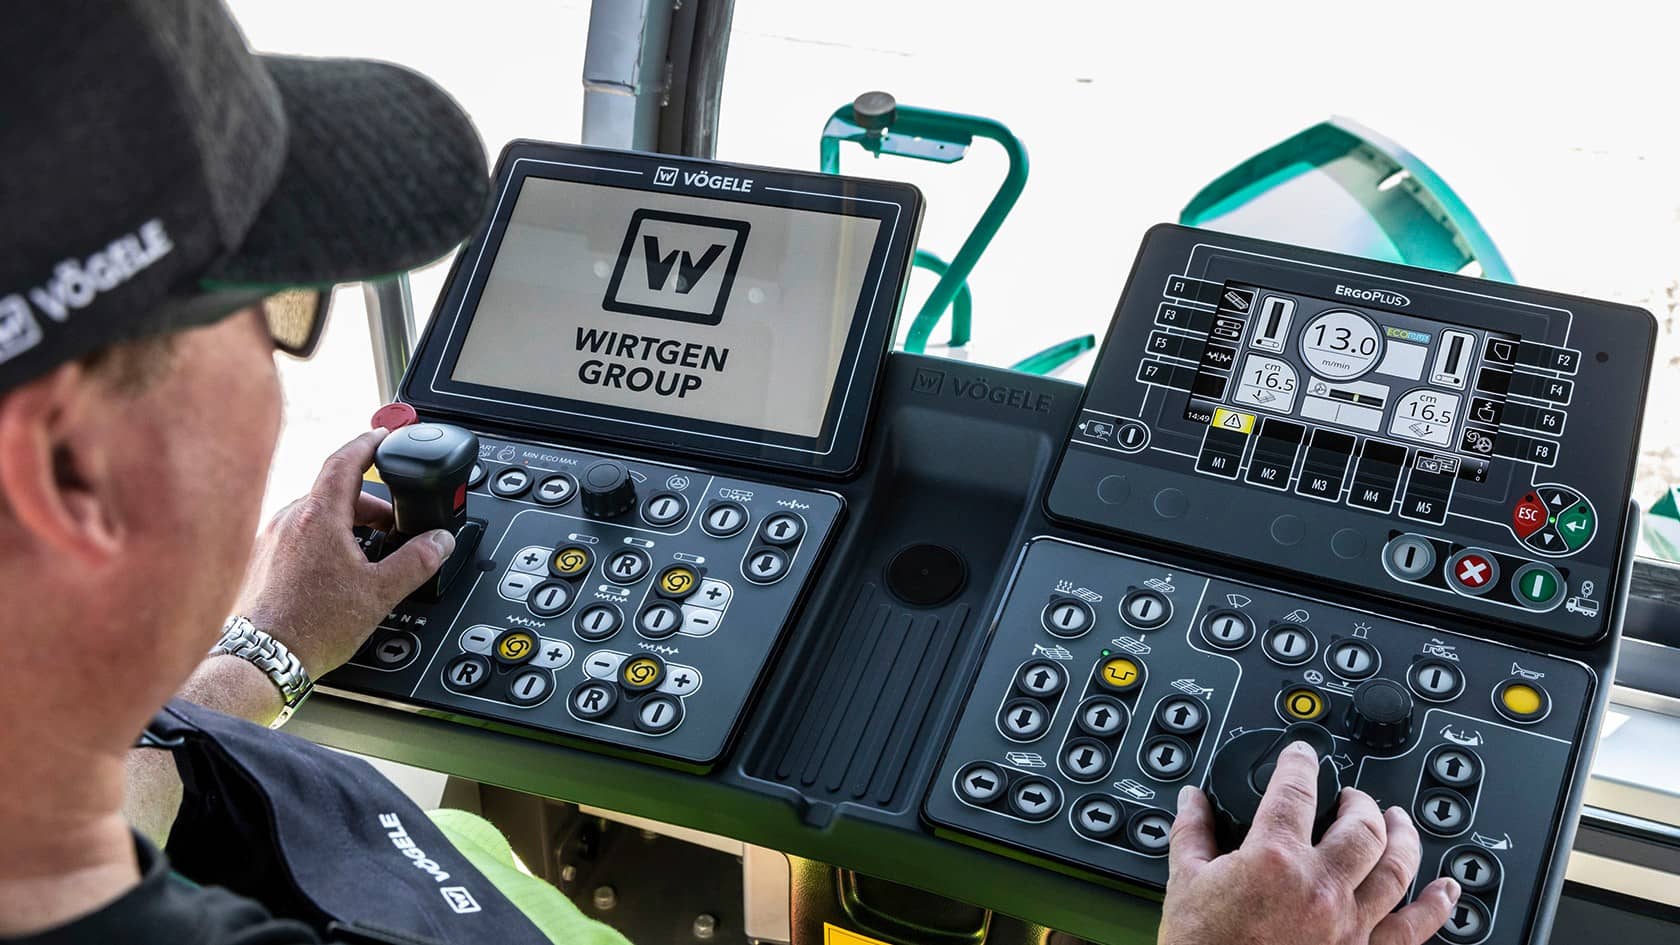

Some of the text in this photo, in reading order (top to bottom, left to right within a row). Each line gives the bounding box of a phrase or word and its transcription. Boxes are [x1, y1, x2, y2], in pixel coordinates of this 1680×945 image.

[684, 170, 754, 193] VÖGELE
[1174, 281, 1186, 293] F1
[1164, 309, 1177, 321] F3
[1155, 337, 1168, 349] F5
[1315, 324, 1376, 356] 13.0
[575, 326, 729, 372] WIRTGEN
[1264, 362, 1281, 372] cm
[1321, 358, 1350, 371] m/min
[1557, 354, 1571, 367] F2
[1145, 365, 1159, 377] F7
[578, 359, 702, 399] GROUP
[1255, 369, 1295, 392] 16.5
[953, 376, 1054, 413] VÖGELE
[1550, 383, 1563, 396] F4
[1419, 394, 1437, 404] cm
[1188, 411, 1210, 422] 14:49
[1409, 401, 1451, 424] 16.5
[1543, 414, 1556, 427] F6
[522, 451, 579, 466] MIN ECO MAX
[1535, 445, 1549, 458] F8
[1211, 456, 1226, 470] M1
[1260, 467, 1277, 481] M2
[1311, 478, 1328, 492] M3
[1363, 489, 1380, 503] M4
[1415, 501, 1432, 515] M5
[1518, 507, 1539, 522] ESC
[378, 812, 451, 882] VÖGELE
